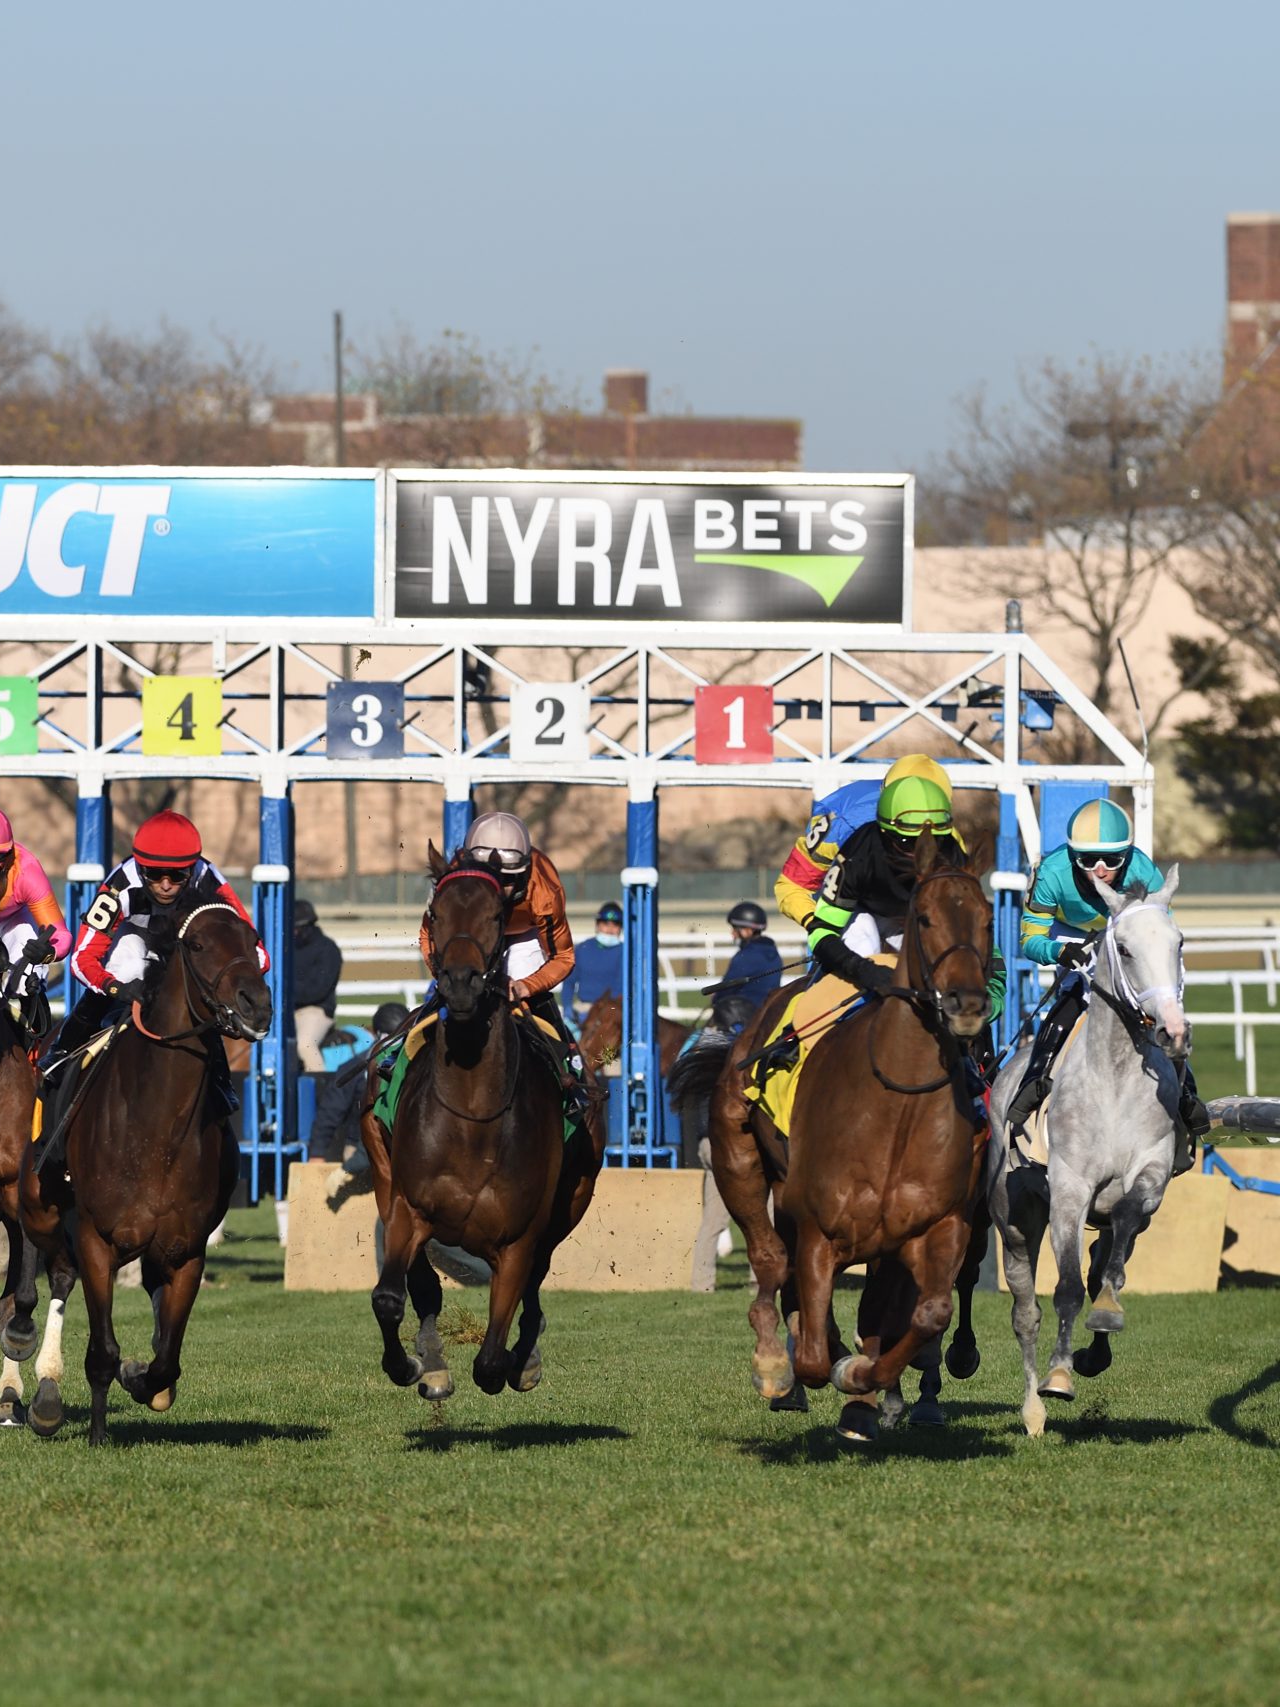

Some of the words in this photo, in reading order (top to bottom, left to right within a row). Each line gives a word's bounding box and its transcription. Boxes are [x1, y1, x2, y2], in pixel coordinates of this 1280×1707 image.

[431, 496, 682, 607] NYRA
[694, 500, 867, 551] BETS
[166, 693, 197, 740] 4
[350, 695, 382, 747] 3
[534, 698, 565, 746] 2
[722, 697, 746, 749] 1
[806, 816, 829, 849] 3
[823, 865, 840, 901] 4
[87, 893, 118, 930] 6
